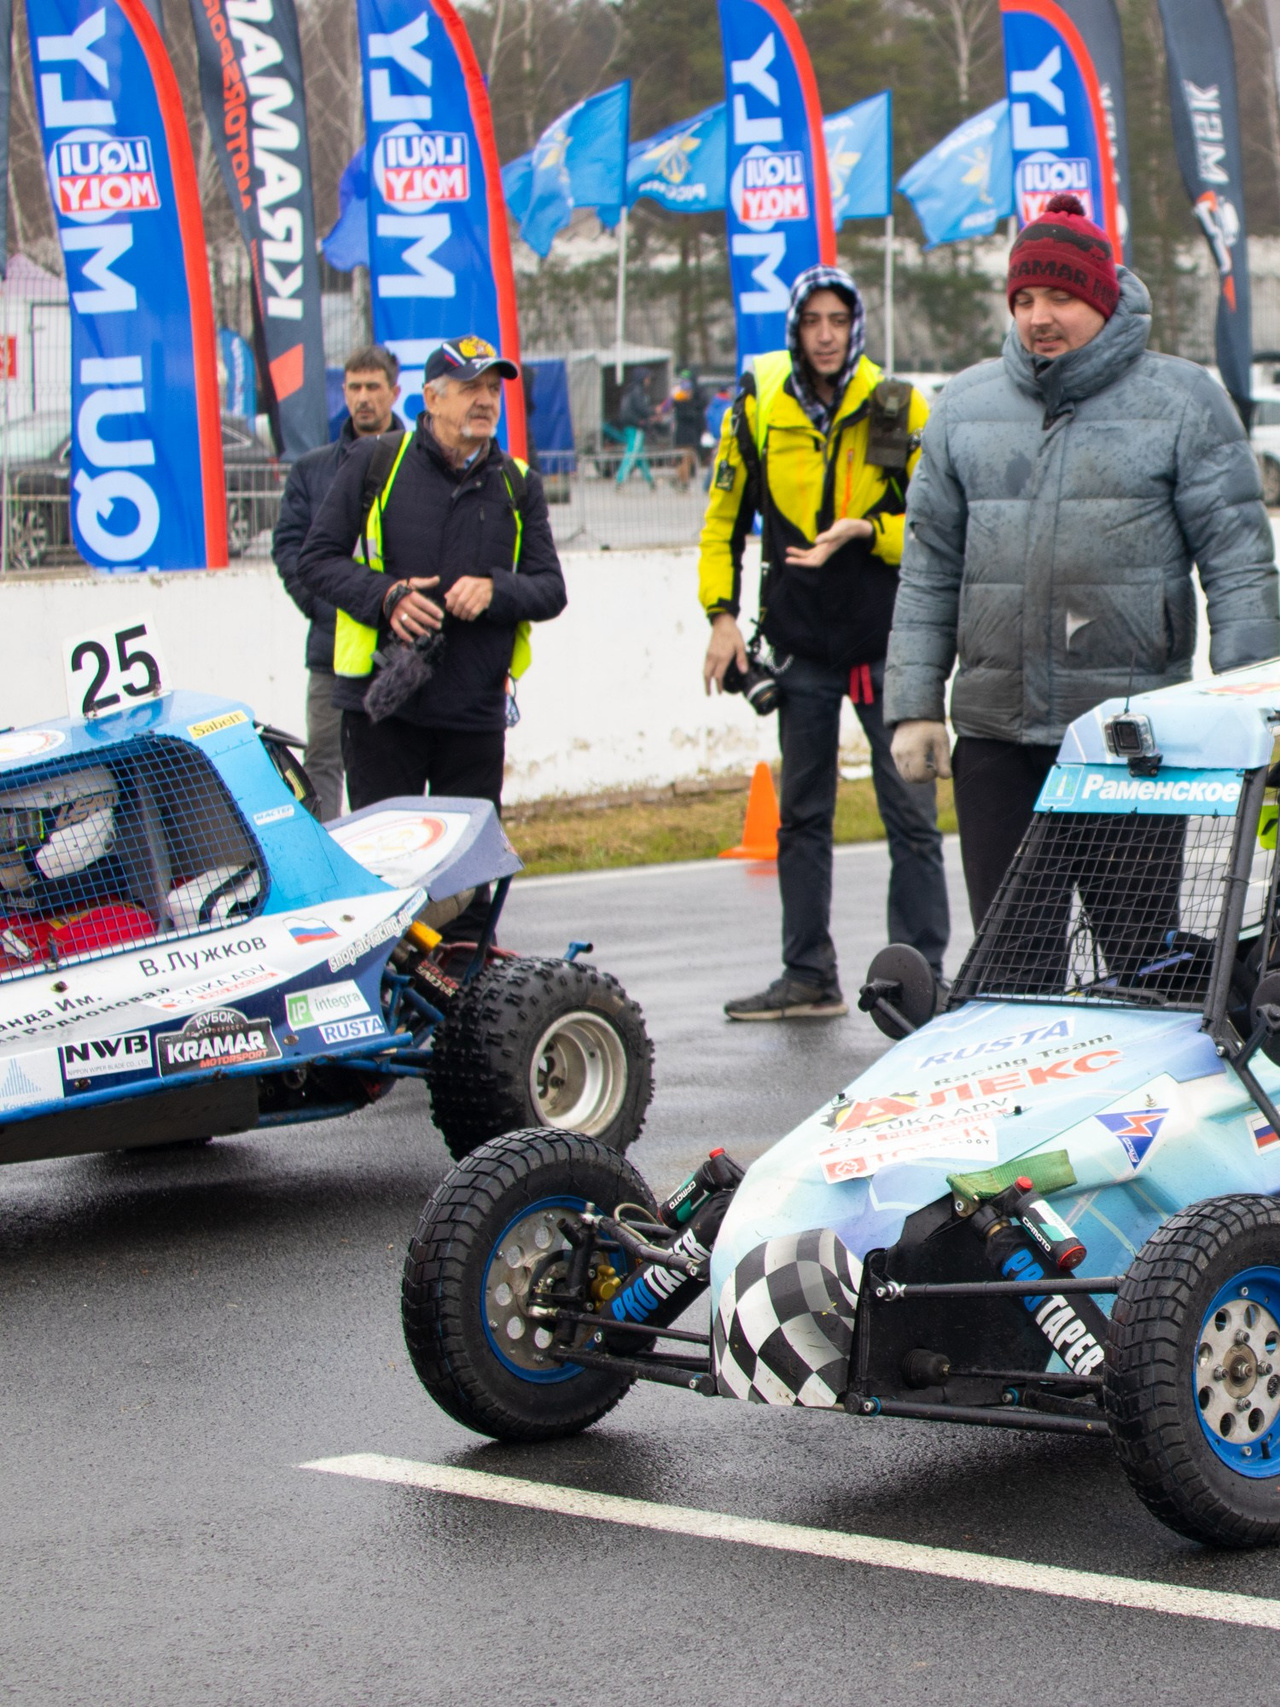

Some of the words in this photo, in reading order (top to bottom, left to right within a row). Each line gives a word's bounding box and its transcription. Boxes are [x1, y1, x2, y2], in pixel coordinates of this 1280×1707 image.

[71, 624, 163, 716] 25
[192, 711, 244, 737] Sabelt
[1081, 774, 1243, 802] Раменское
[314, 990, 362, 1013] integra
[195, 1012, 235, 1029] КУБОК
[323, 1016, 385, 1043] RUSTA
[65, 1034, 149, 1064] NWB
[167, 1030, 268, 1064] KRAMAR
[200, 1048, 268, 1069] MOTORSPORT
[919, 1019, 1069, 1069] RUSTA
[934, 1056, 1029, 1087] Racing
[1036, 1033, 1113, 1059] Team
[669, 1181, 697, 1210] CFMOTO
[1022, 1216, 1052, 1252] CFMOTO
